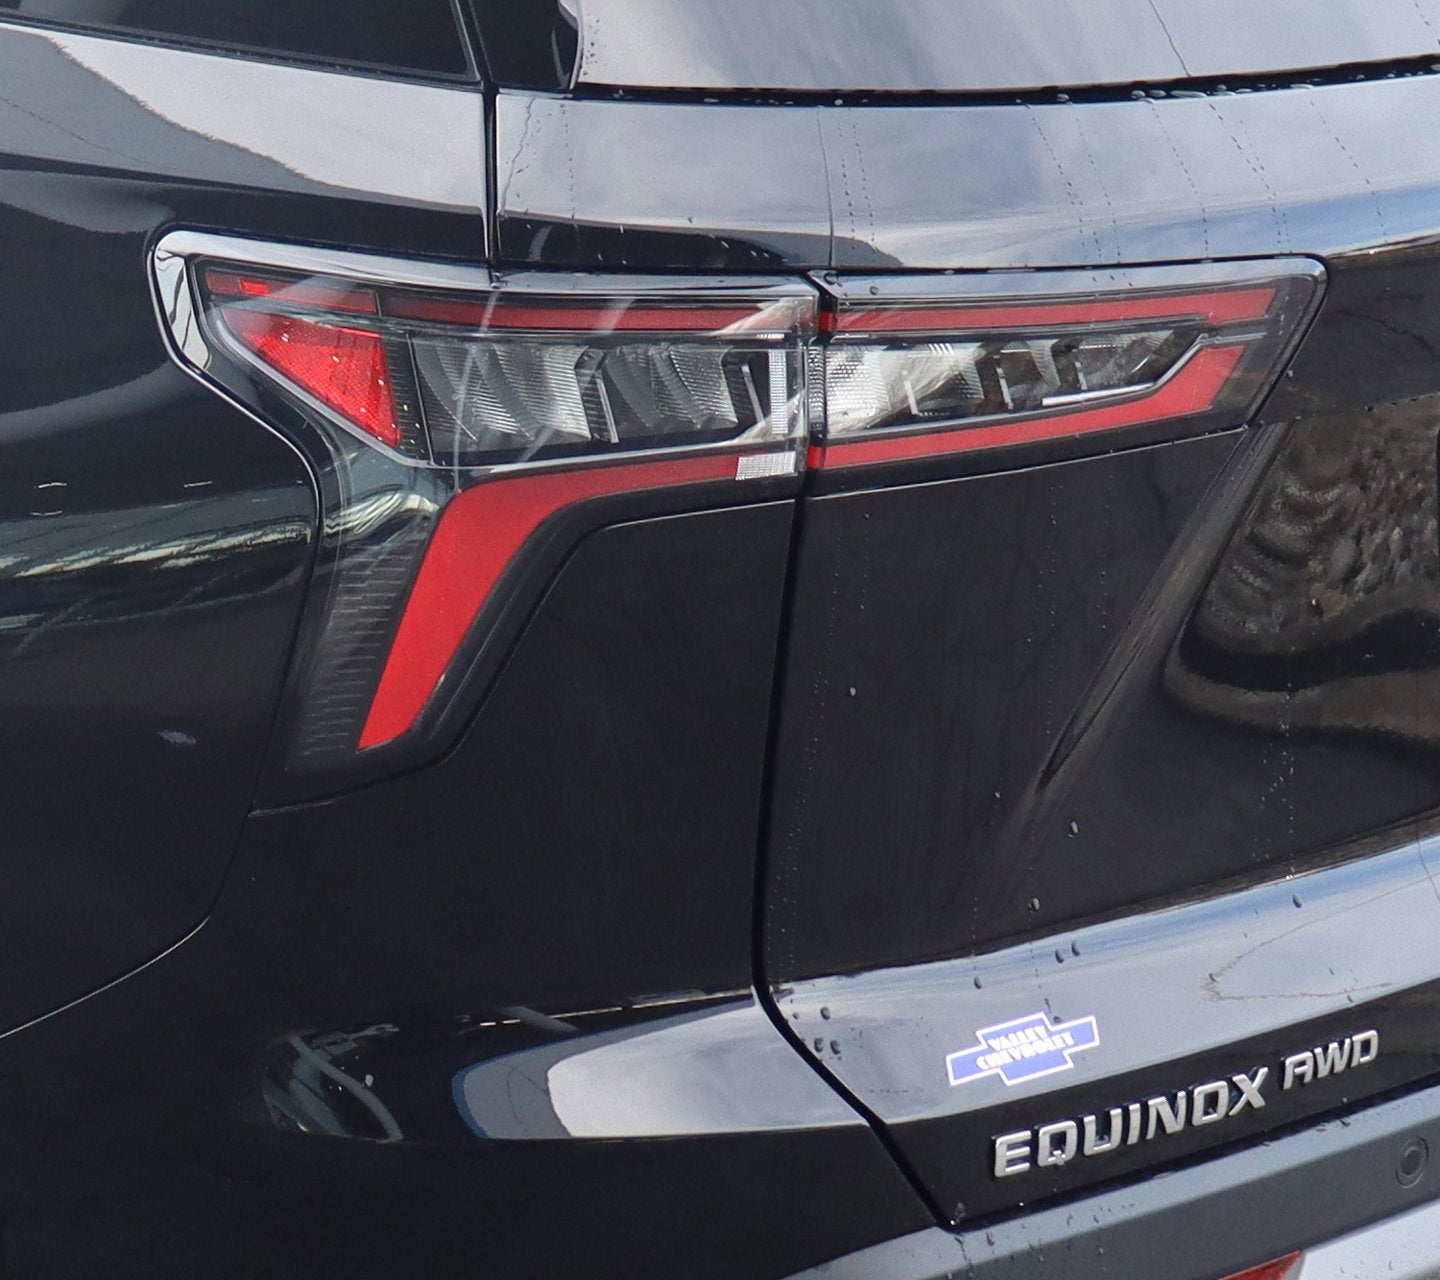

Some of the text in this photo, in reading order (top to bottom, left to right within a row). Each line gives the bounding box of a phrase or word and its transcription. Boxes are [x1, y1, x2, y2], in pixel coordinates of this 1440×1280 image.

[975, 1031, 1075, 1070] CHEVROLET
[987, 1024, 1048, 1051] VALLEY
[993, 1029, 1380, 1178] EQUINOX AWD
